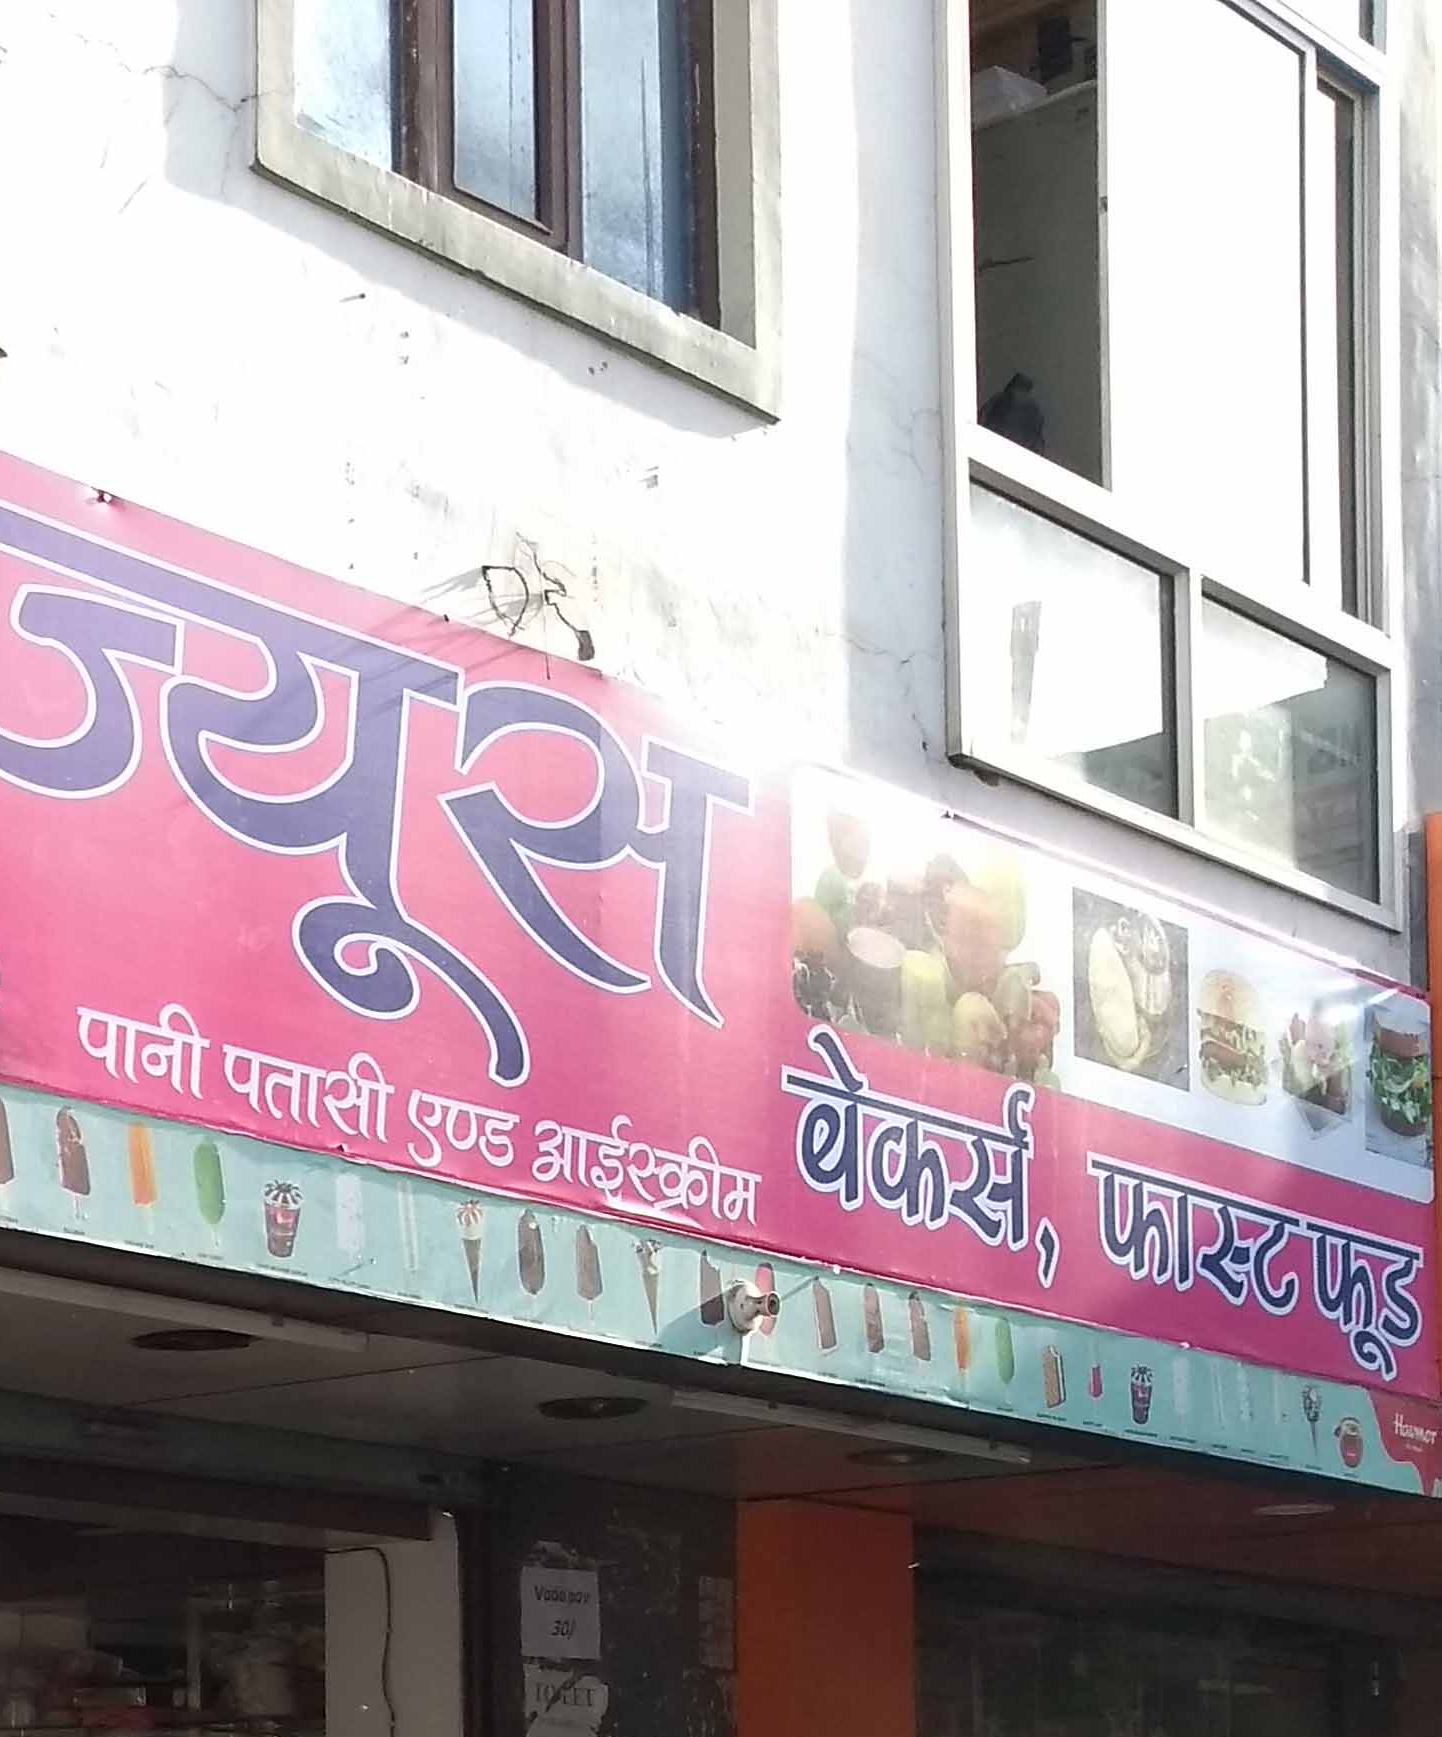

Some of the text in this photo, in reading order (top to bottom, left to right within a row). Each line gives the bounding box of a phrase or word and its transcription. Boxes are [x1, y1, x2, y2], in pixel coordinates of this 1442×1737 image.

[76, 1004, 209, 1098] पानी
[222, 1040, 395, 1145] पतासी
[406, 1089, 520, 1167] एण्ड
